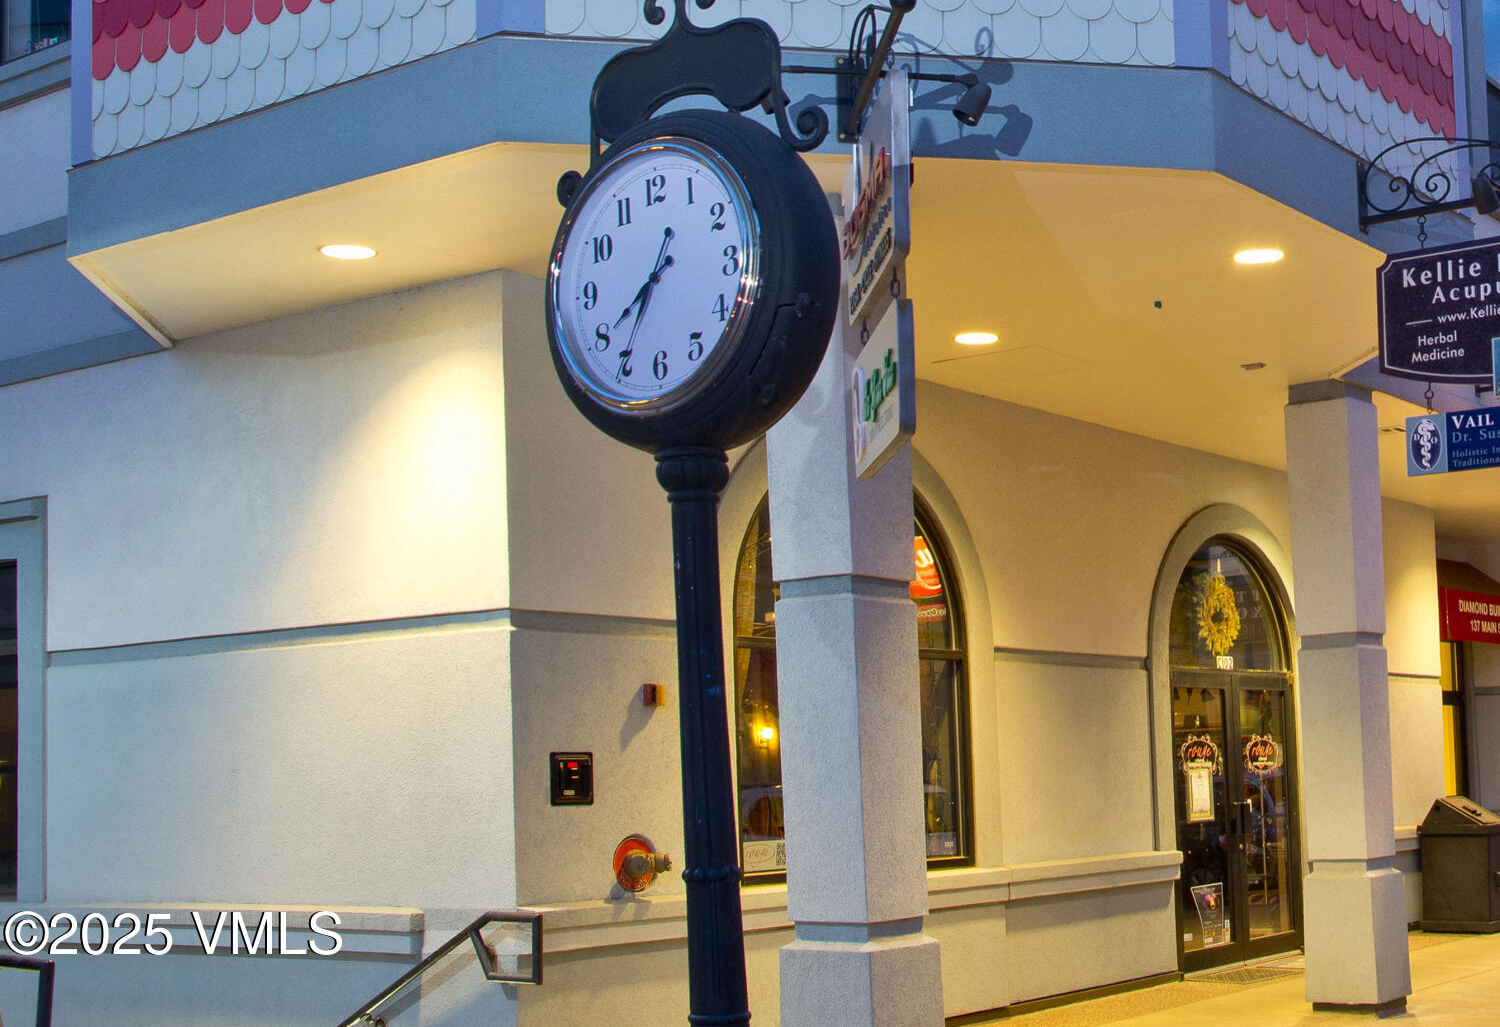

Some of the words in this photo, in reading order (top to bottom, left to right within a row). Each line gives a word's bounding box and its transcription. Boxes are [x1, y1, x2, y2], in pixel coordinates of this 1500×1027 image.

[645, 174, 667, 207] 12
[686, 177, 696, 206] 1
[616, 196, 633, 227] 11
[710, 202, 726, 232] 2
[592, 234, 612, 263] 10
[722, 245, 739, 277] 3
[1402, 258, 1482, 288] Kellie
[583, 281, 598, 310] 9
[711, 293, 730, 322] 4
[594, 323, 611, 352] 8
[688, 332, 703, 361] 5
[1418, 330, 1458, 347] Herbal
[652, 350, 668, 380] 6
[1411, 346, 1465, 364] Medicine
[1451, 413, 1495, 430] VAIL
[1452, 431, 1473, 444] Dr.
[1452, 449, 1488, 458] Holistic
[1458, 600, 1488, 615] DIAMOND
[1470, 620, 1480, 632] 137
[1481, 620, 1497, 634] MAIN
